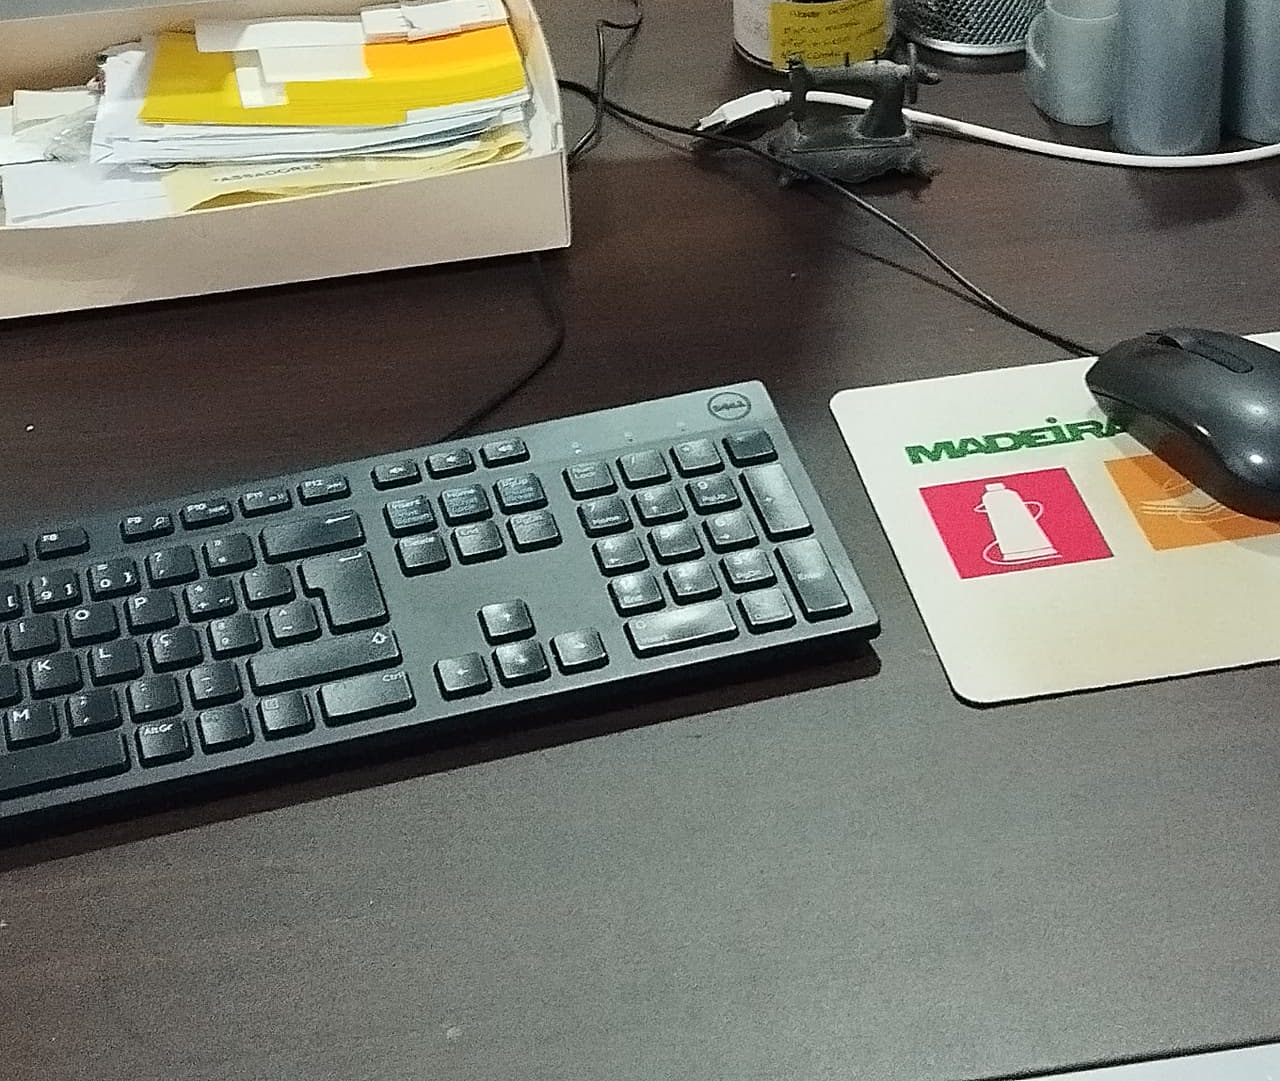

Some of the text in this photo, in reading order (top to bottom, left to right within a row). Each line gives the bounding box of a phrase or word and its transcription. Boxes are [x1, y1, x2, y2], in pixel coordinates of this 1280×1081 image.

[41, 533, 58, 542] F8
[41, 591, 52, 600] 9
[134, 596, 148, 608] P
[75, 609, 89, 620] O
[19, 622, 25, 633] I
[159, 634, 170, 647] Ç
[99, 648, 112, 659] L
[37, 660, 51, 671] K
[382, 670, 403, 682] Ctrl
[12, 708, 30, 721] M
